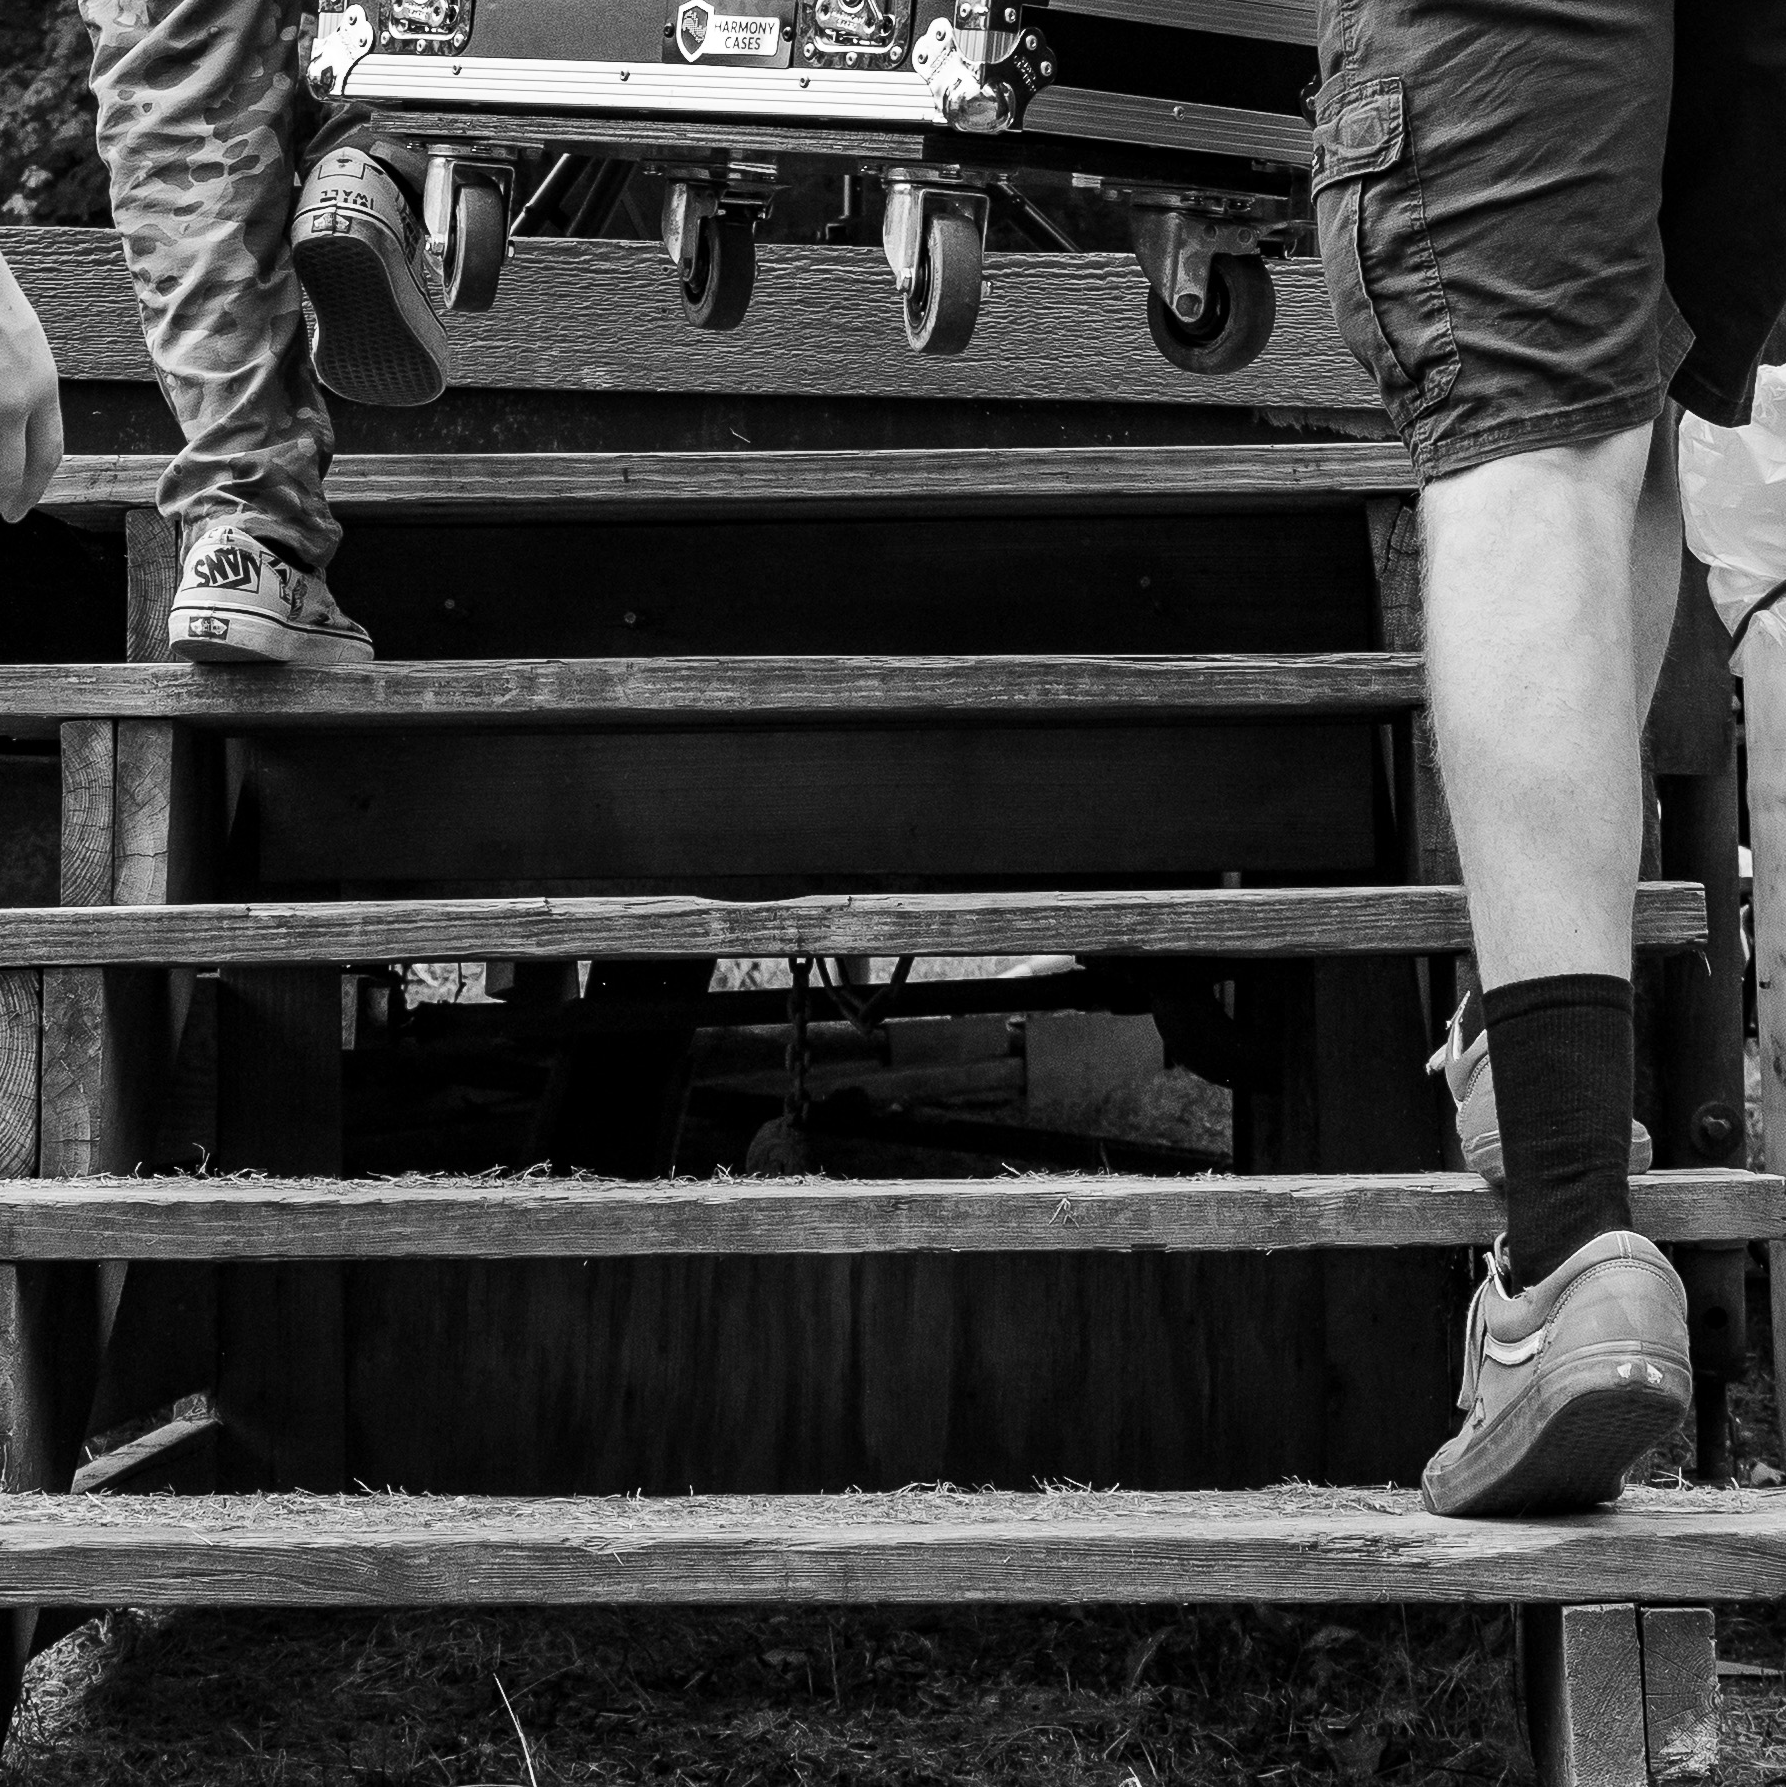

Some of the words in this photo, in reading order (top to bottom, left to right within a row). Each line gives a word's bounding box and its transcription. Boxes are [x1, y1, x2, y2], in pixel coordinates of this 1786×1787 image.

[714, 20, 776, 36] HARMONY
[724, 36, 762, 51] CASES
[194, 546, 261, 595] VANS
